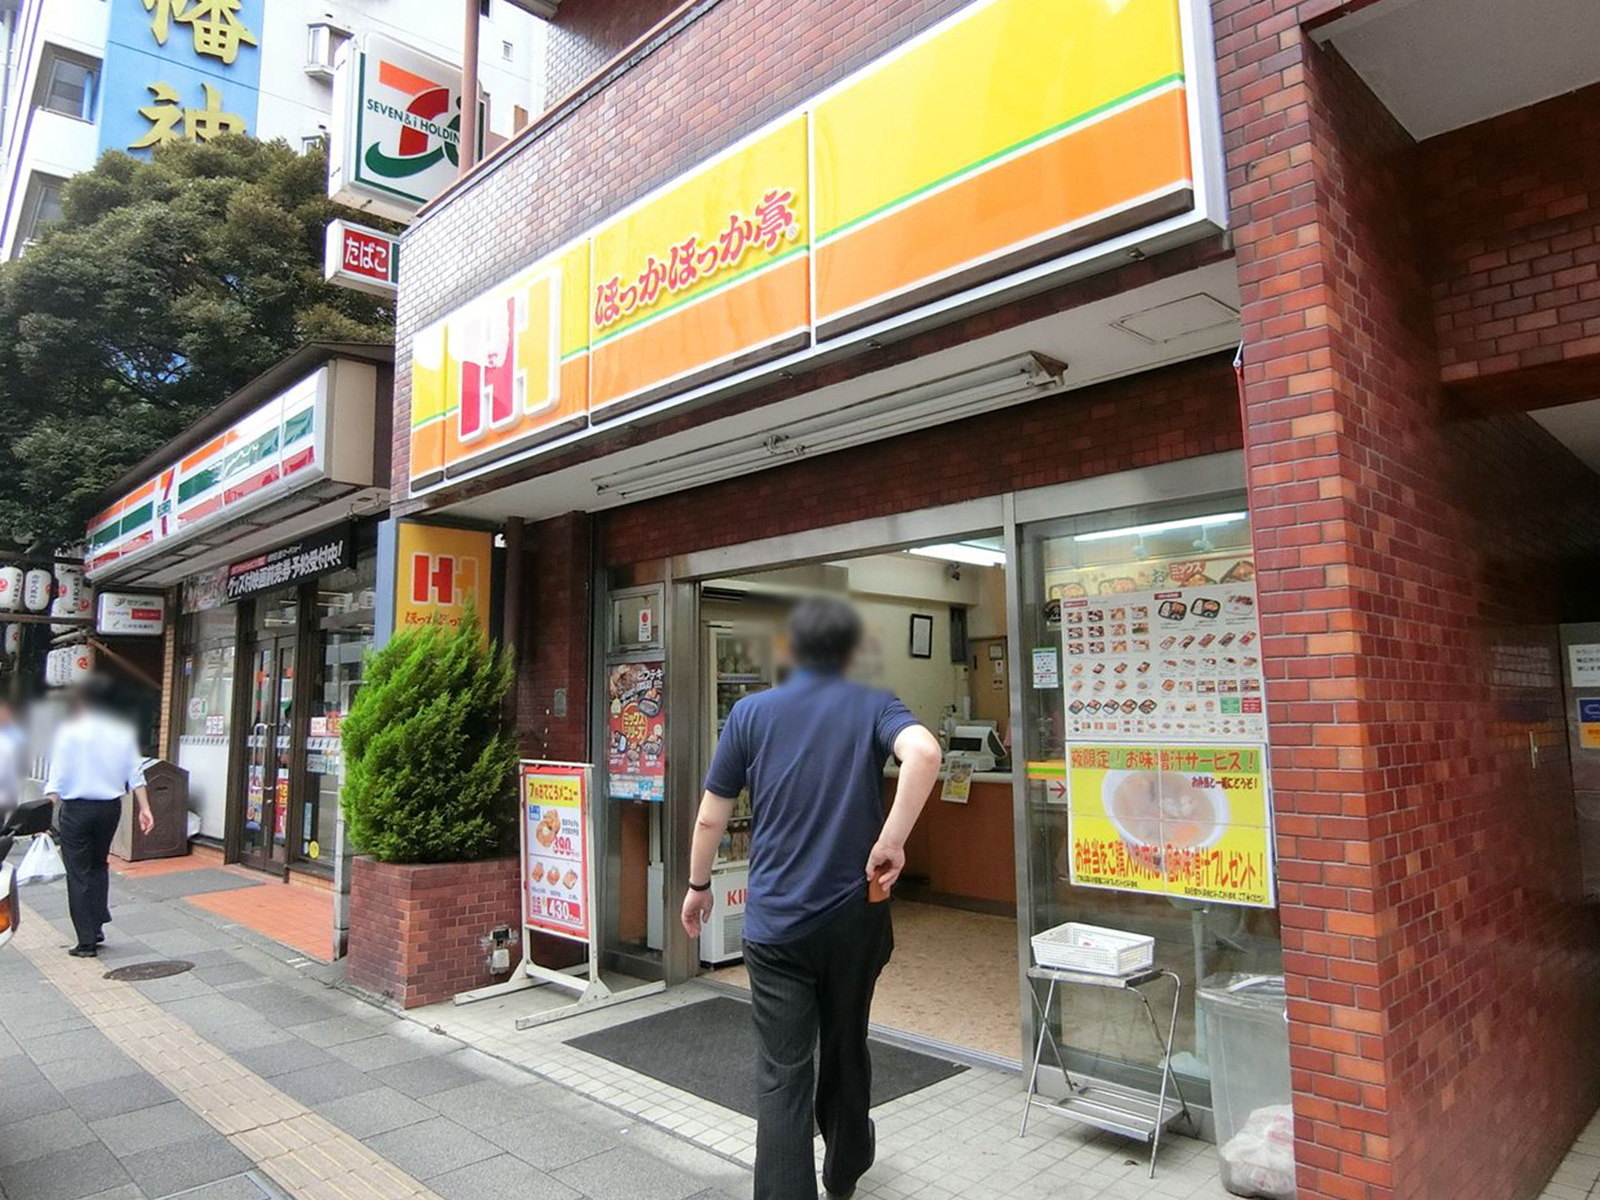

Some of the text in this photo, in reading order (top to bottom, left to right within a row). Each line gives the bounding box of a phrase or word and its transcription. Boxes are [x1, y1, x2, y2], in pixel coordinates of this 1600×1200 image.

[420, 119, 461, 144] HOLDIN
[346, 236, 387, 273] たばこ
[594, 190, 792, 326] ほっかほっか亭
[549, 898, 570, 920] 430
